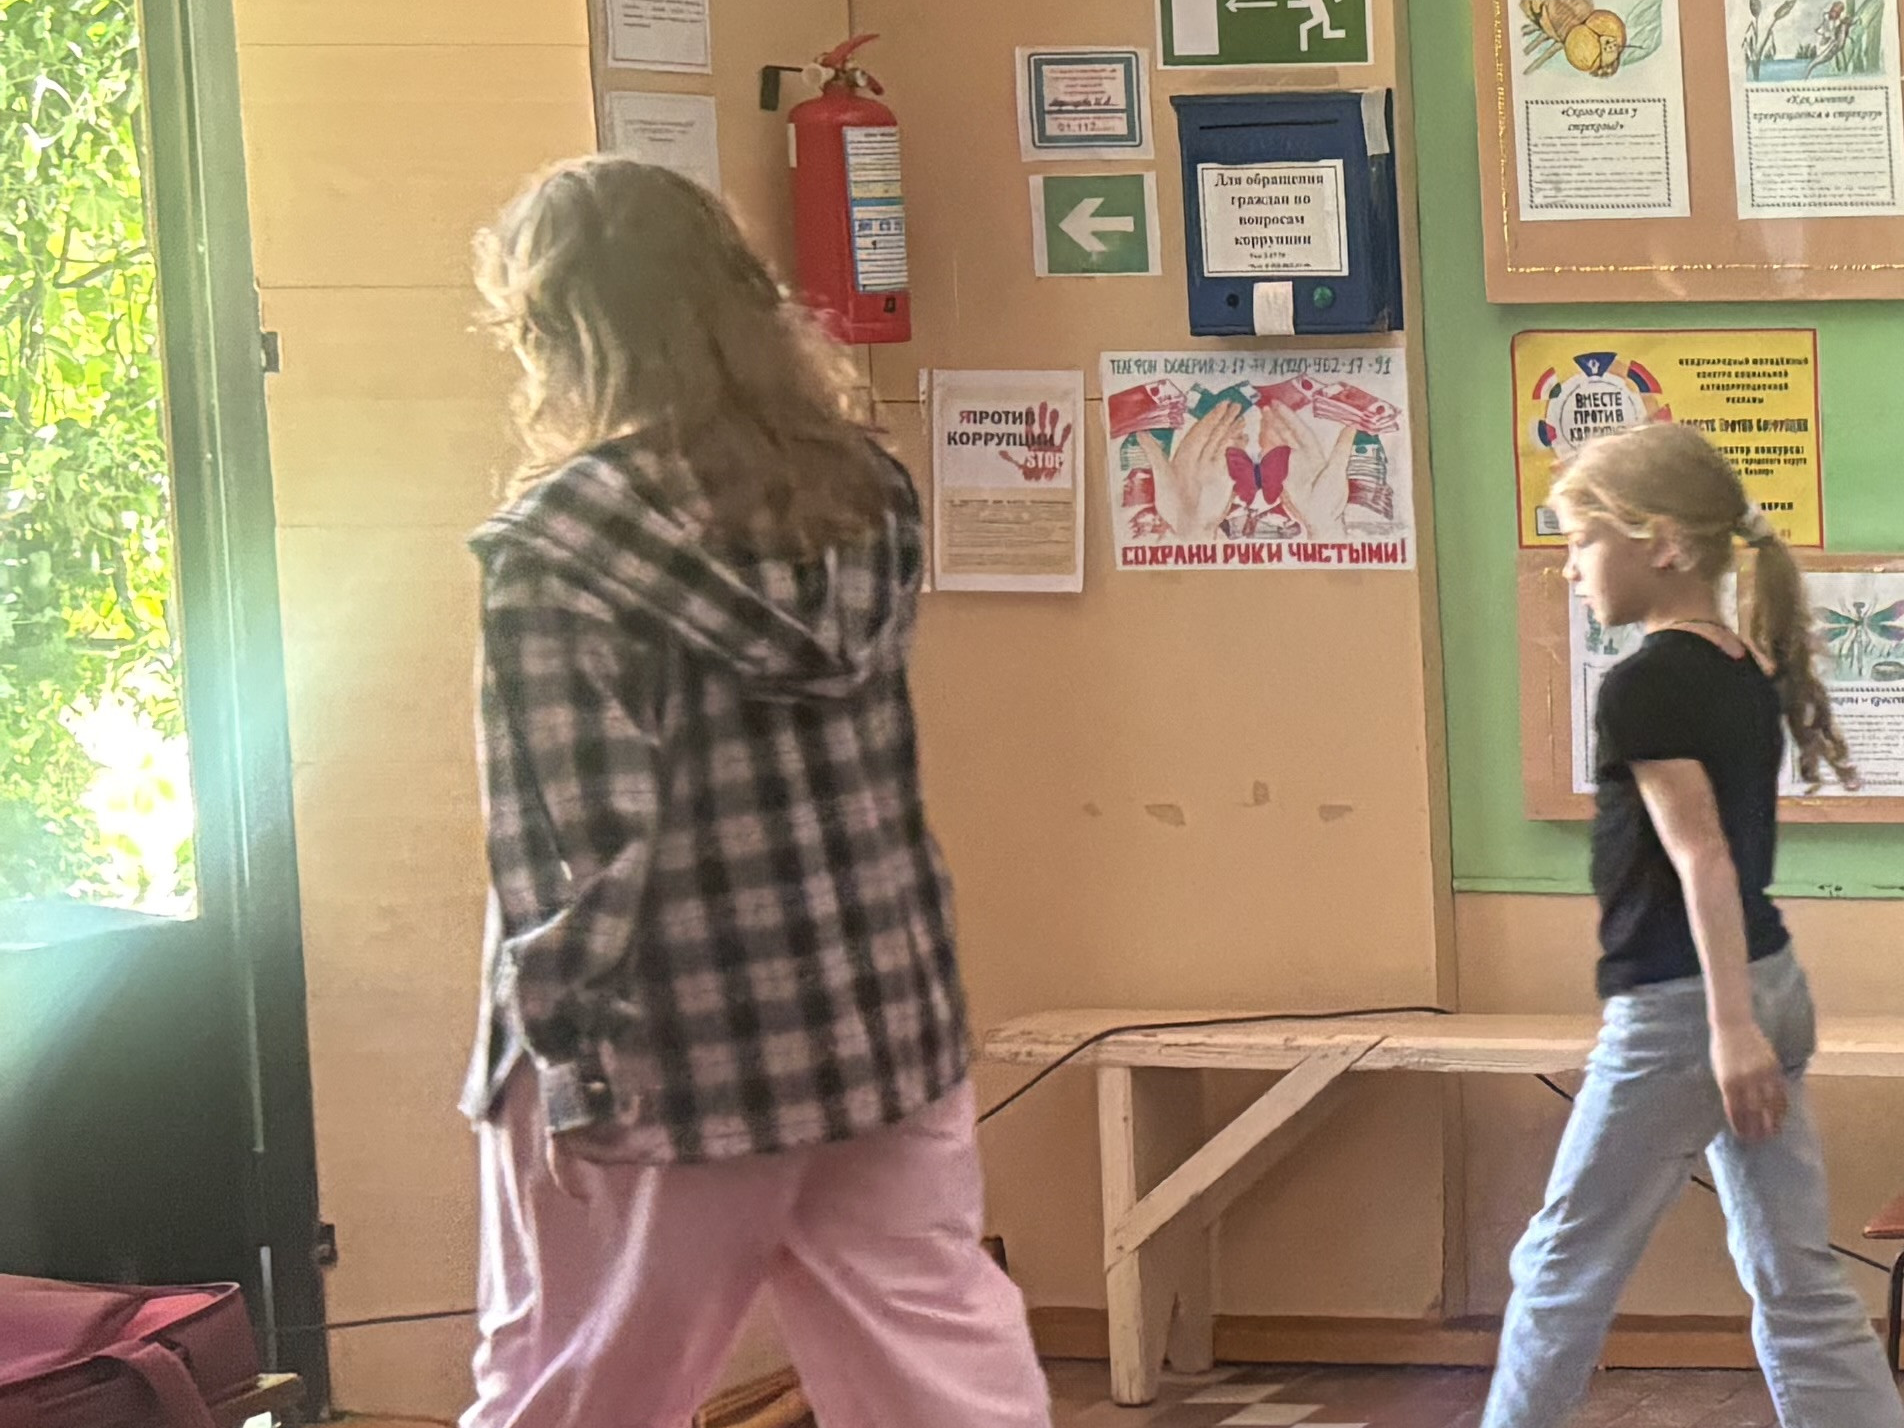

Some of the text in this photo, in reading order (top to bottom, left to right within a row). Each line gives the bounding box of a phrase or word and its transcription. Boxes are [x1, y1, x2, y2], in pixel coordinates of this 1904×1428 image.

[1215, 173, 1324, 188] Для обращения
[1231, 195, 1311, 208] граждан по
[1239, 215, 1304, 228] вопросам
[1234, 235, 1312, 249] коррупции
[1576, 392, 1622, 408] ВМЕСТЕ
[1574, 409, 1624, 424] ПРОТИВ
[1026, 452, 1063, 468] STOP
[1122, 537, 1407, 566] СОХРАНИ РУКИ ЧИСТЫМИ!
